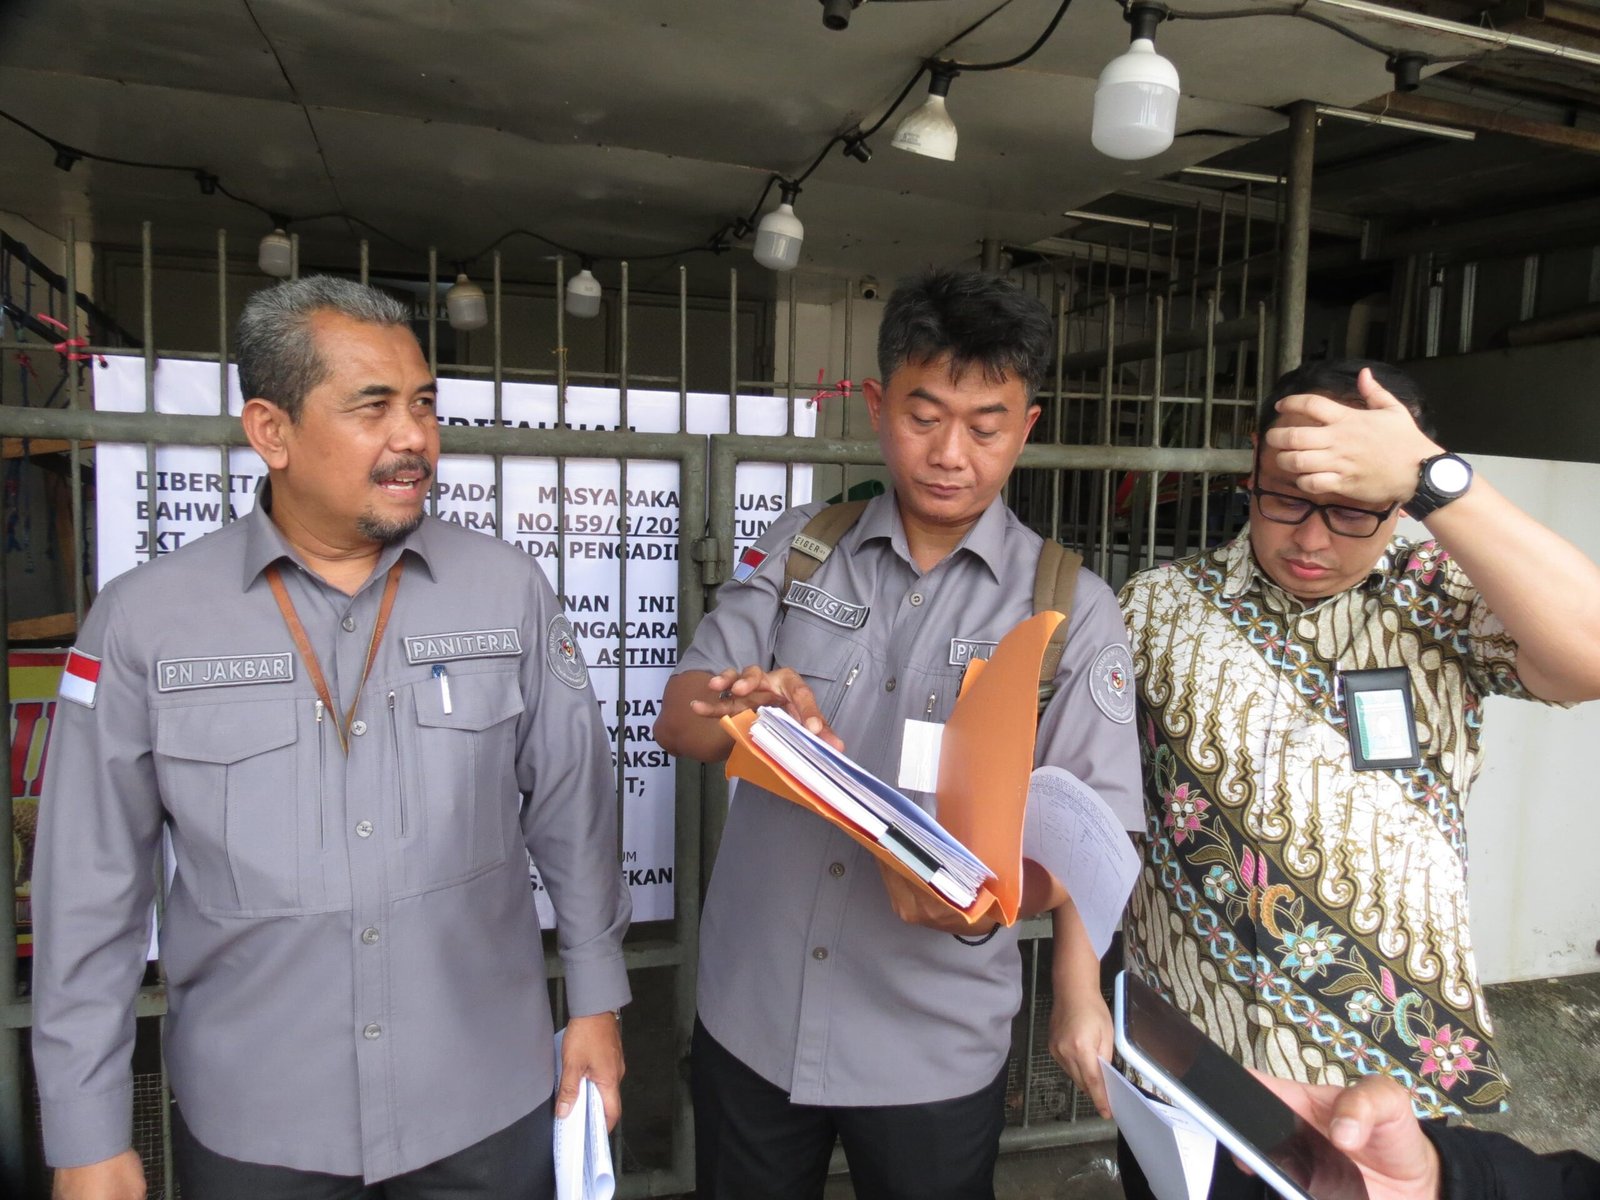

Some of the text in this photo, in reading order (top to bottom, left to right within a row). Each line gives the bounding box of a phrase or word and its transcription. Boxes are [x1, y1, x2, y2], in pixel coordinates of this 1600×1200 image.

[425, 482, 497, 502] PADA
[538, 486, 680, 508] MASYARAKA
[734, 493, 783, 512] UAS
[505, 540, 559, 558] ADA
[569, 541, 679, 561] PENGADI
[794, 536, 821, 554] EIGER
[562, 595, 675, 613] NAN INI
[788, 585, 861, 625] JURUSITA
[569, 621, 678, 639] NGACARA
[412, 632, 515, 659] PANITERA
[165, 658, 286, 685] PN JAKBAR
